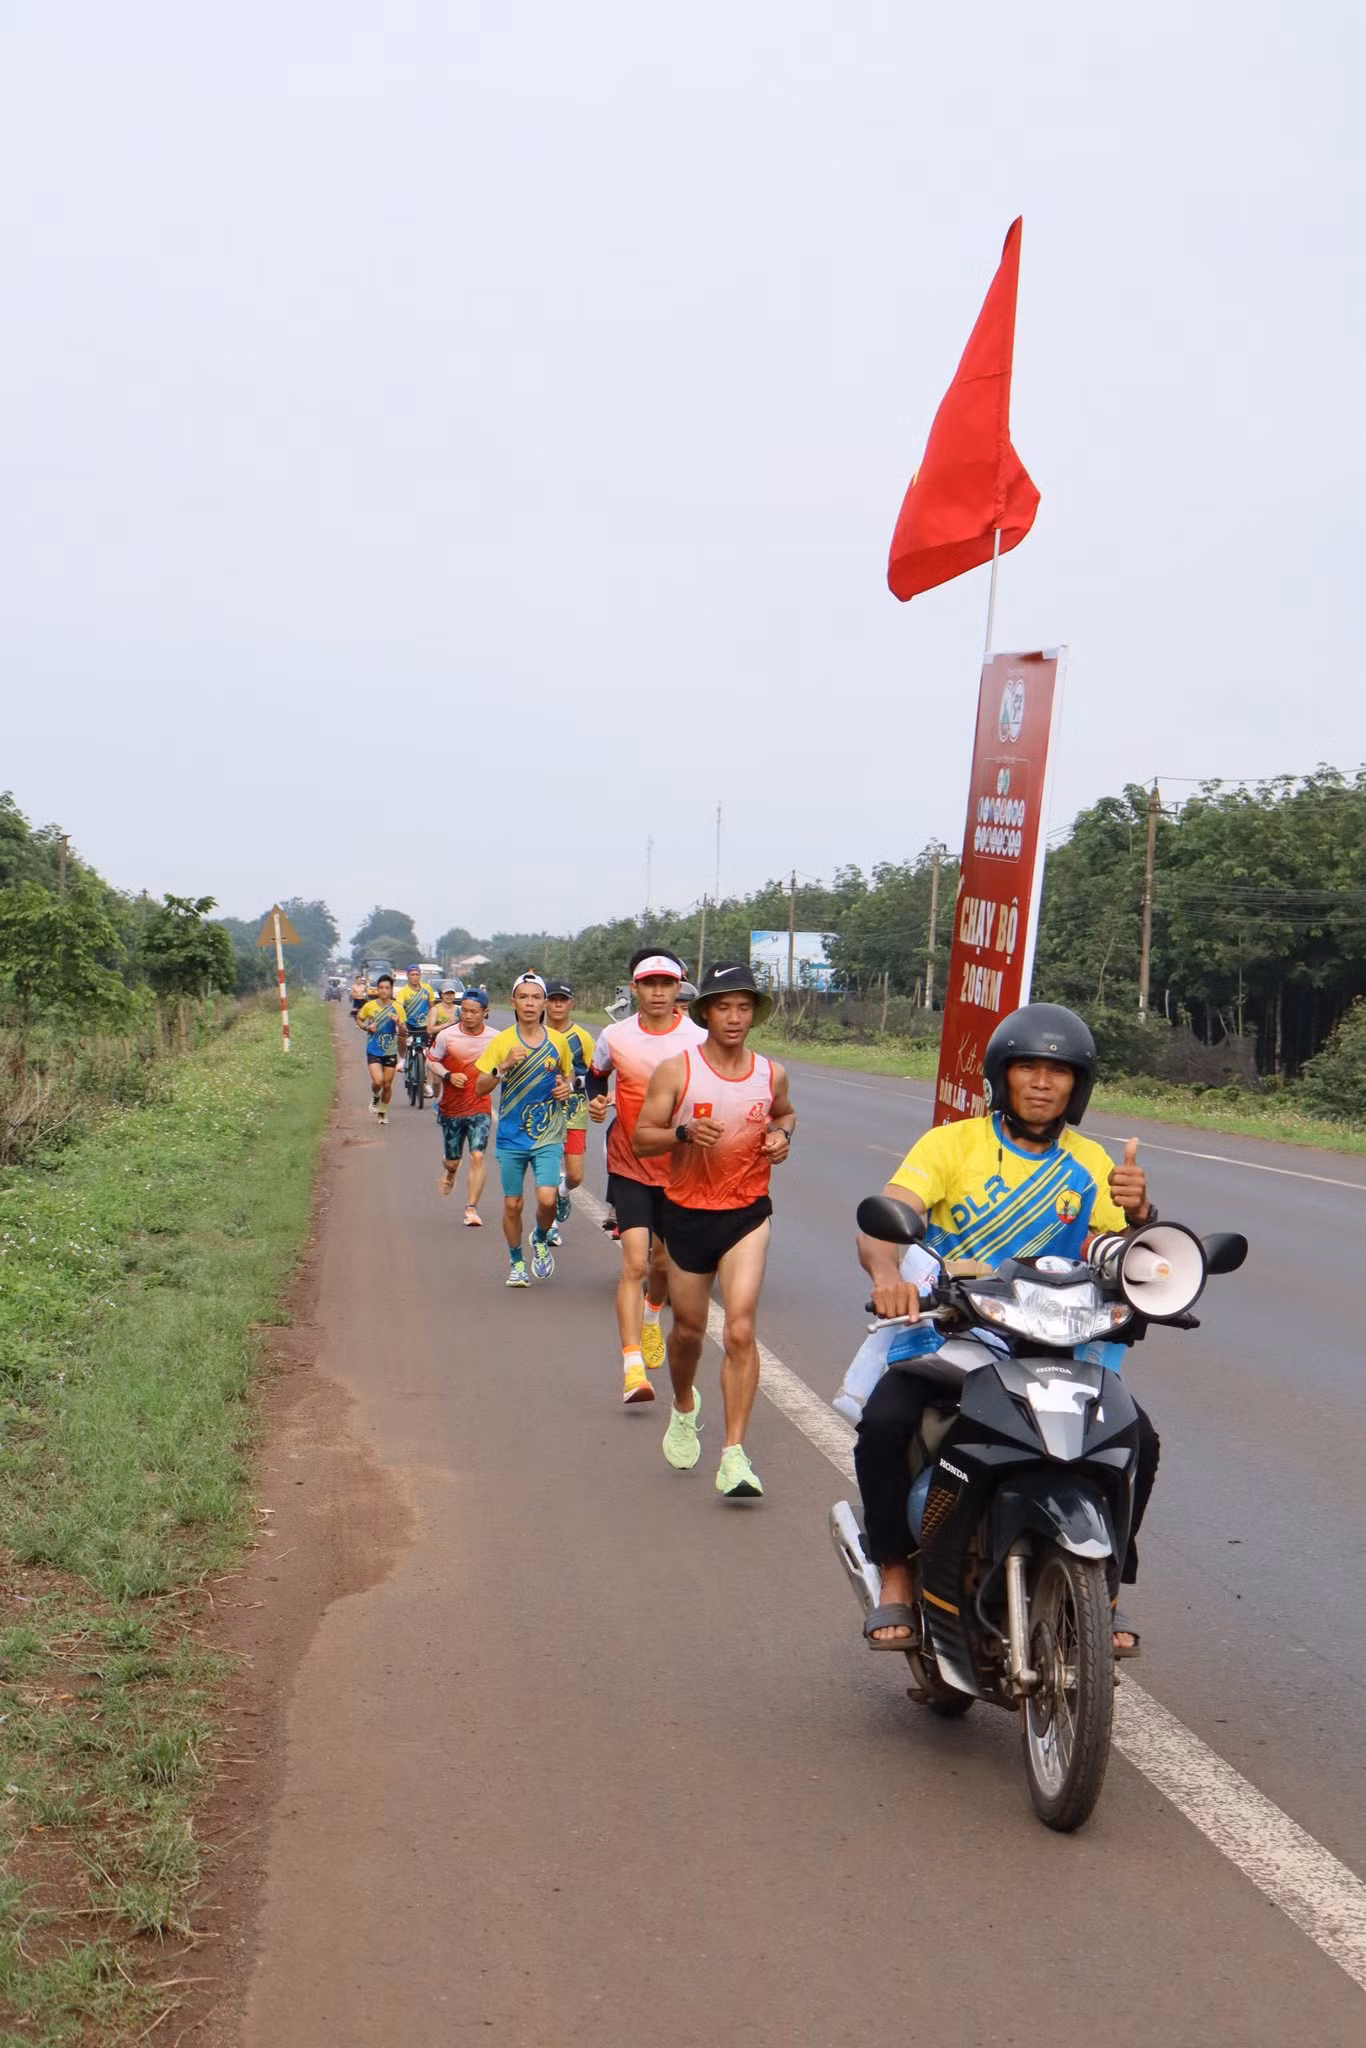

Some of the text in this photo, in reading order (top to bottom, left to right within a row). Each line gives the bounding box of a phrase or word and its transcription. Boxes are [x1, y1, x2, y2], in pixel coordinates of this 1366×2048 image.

[960, 896, 1018, 965] CHẠY BỘ
[960, 961, 1003, 1013] 206KM
[951, 1174, 1012, 1230] DLR
[1036, 1366, 1072, 1375] HONDA
[940, 1457, 969, 1483] HONDA
